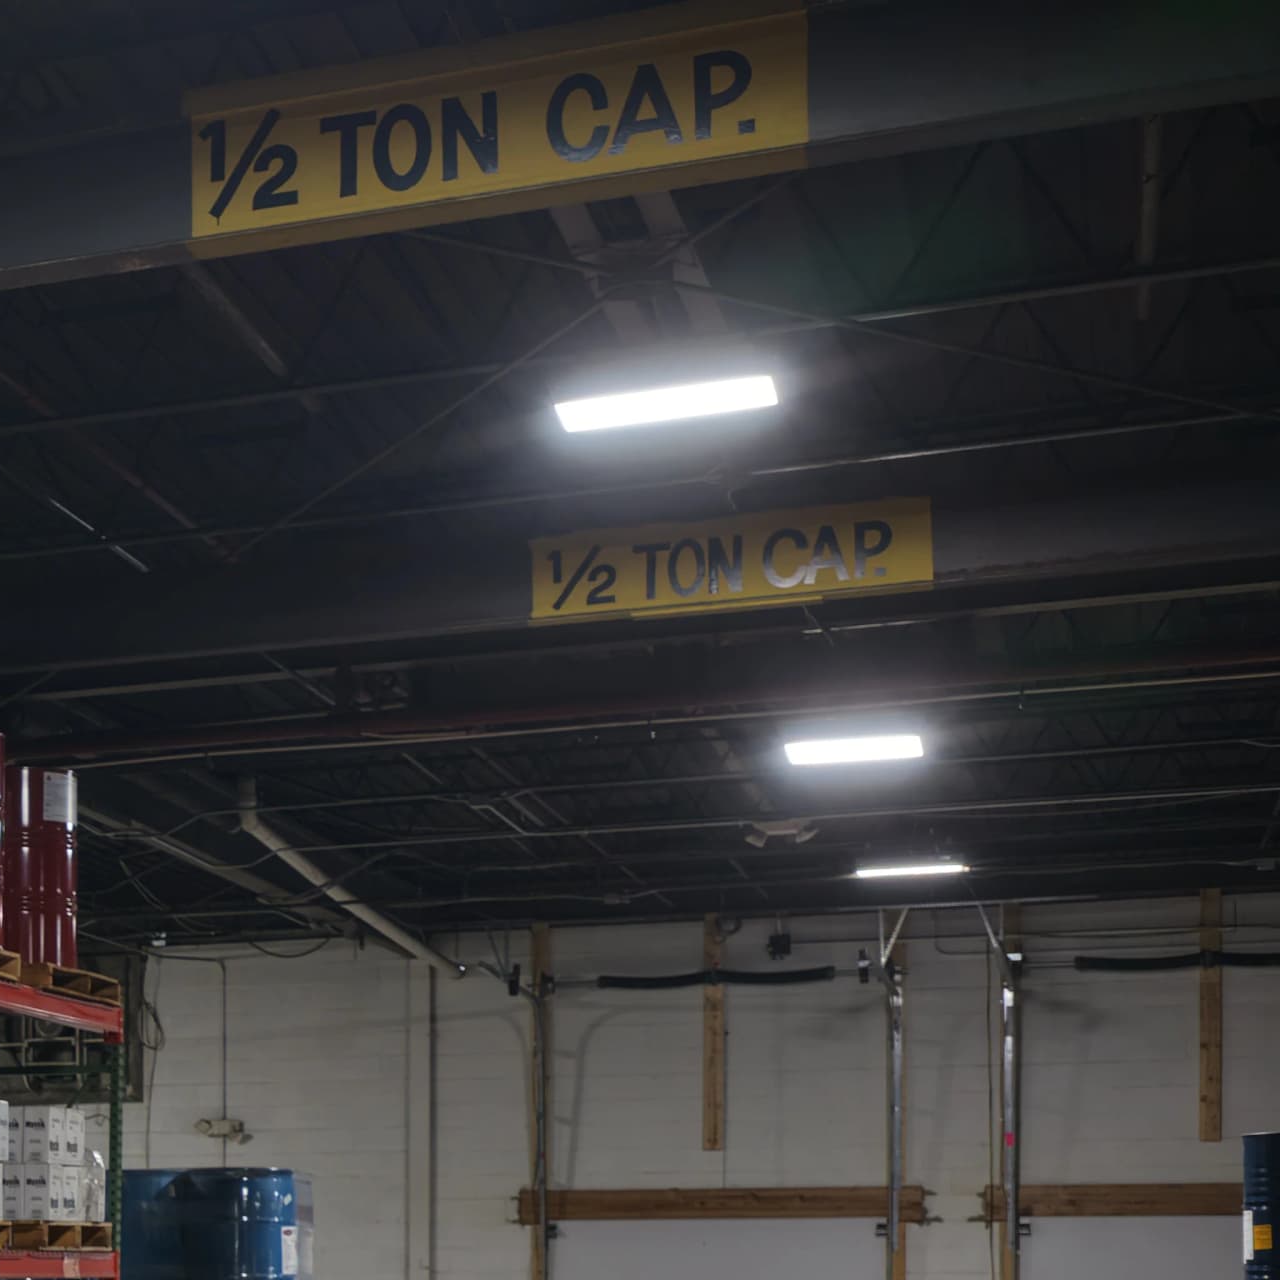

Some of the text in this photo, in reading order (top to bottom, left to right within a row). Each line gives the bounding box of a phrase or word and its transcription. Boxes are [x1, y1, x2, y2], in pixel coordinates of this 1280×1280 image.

[320, 91, 498, 197] TON
[545, 50, 757, 163] CAP.
[633, 533, 743, 598] TON
